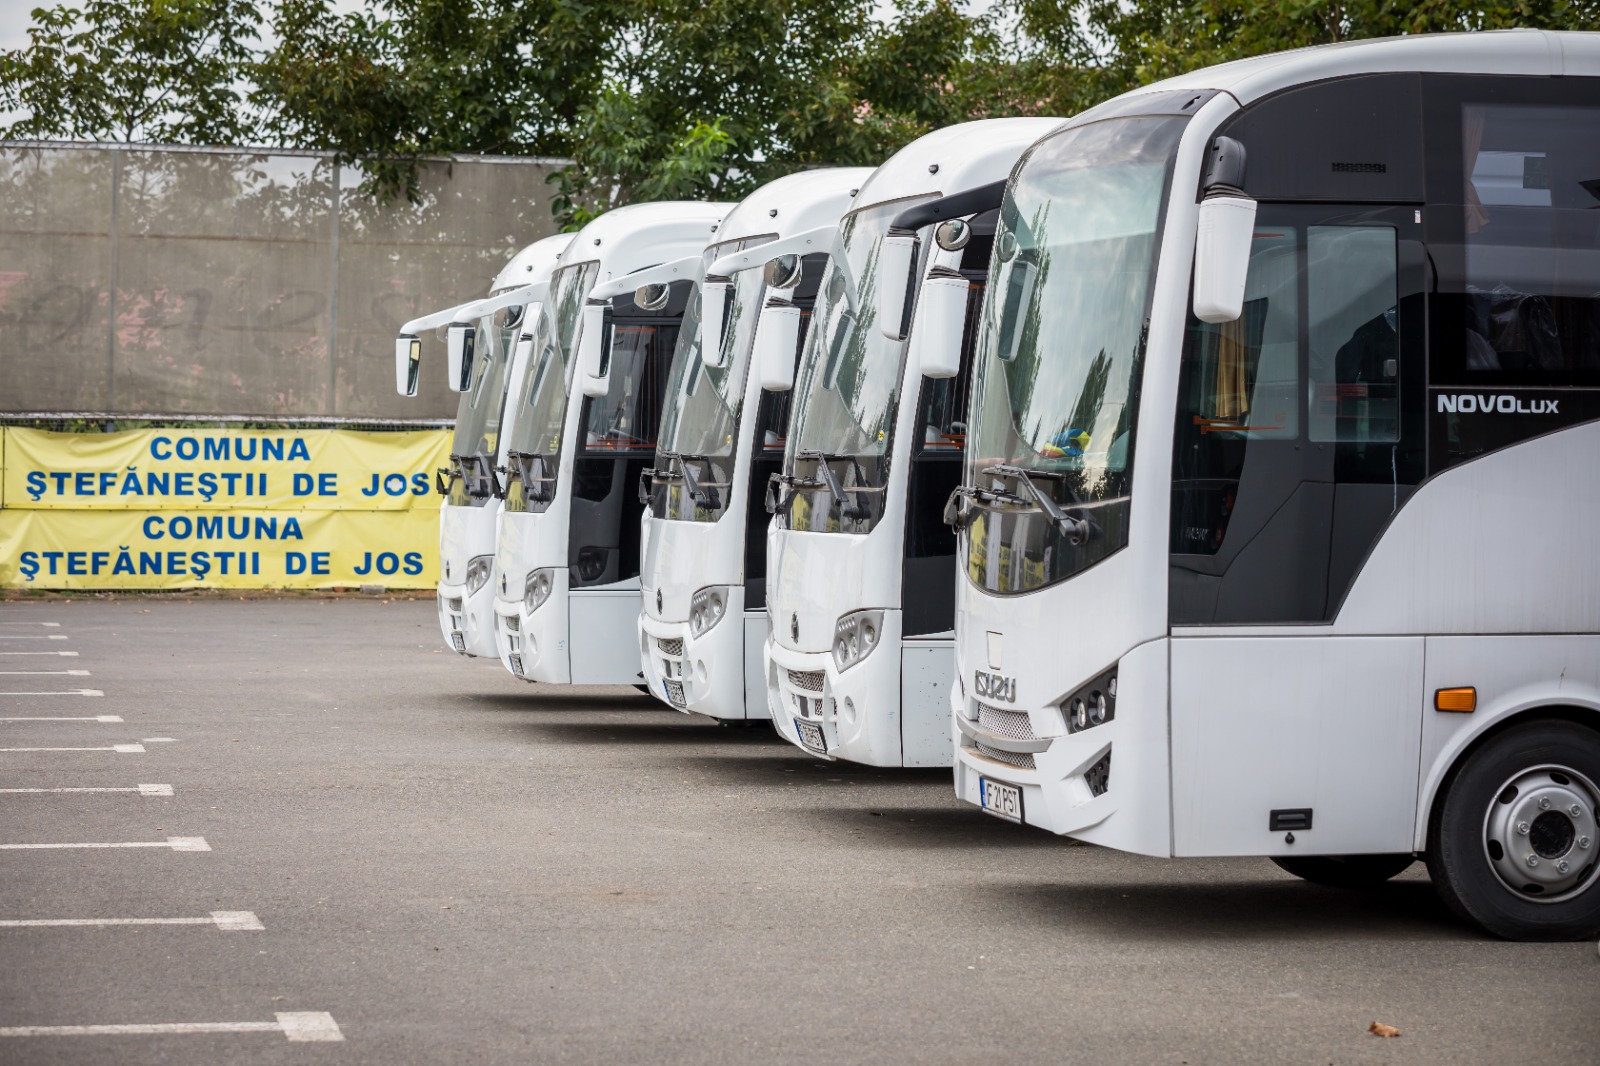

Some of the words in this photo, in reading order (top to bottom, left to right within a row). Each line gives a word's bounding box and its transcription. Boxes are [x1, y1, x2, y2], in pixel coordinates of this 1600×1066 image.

[149, 436, 312, 461] COMUNA
[292, 473, 338, 497] DE
[361, 473, 431, 497] JOS
[143, 515, 304, 540] COMUNA
[285, 551, 331, 575] DE
[353, 551, 424, 576] JOS
[976, 670, 1016, 703] ISUZU
